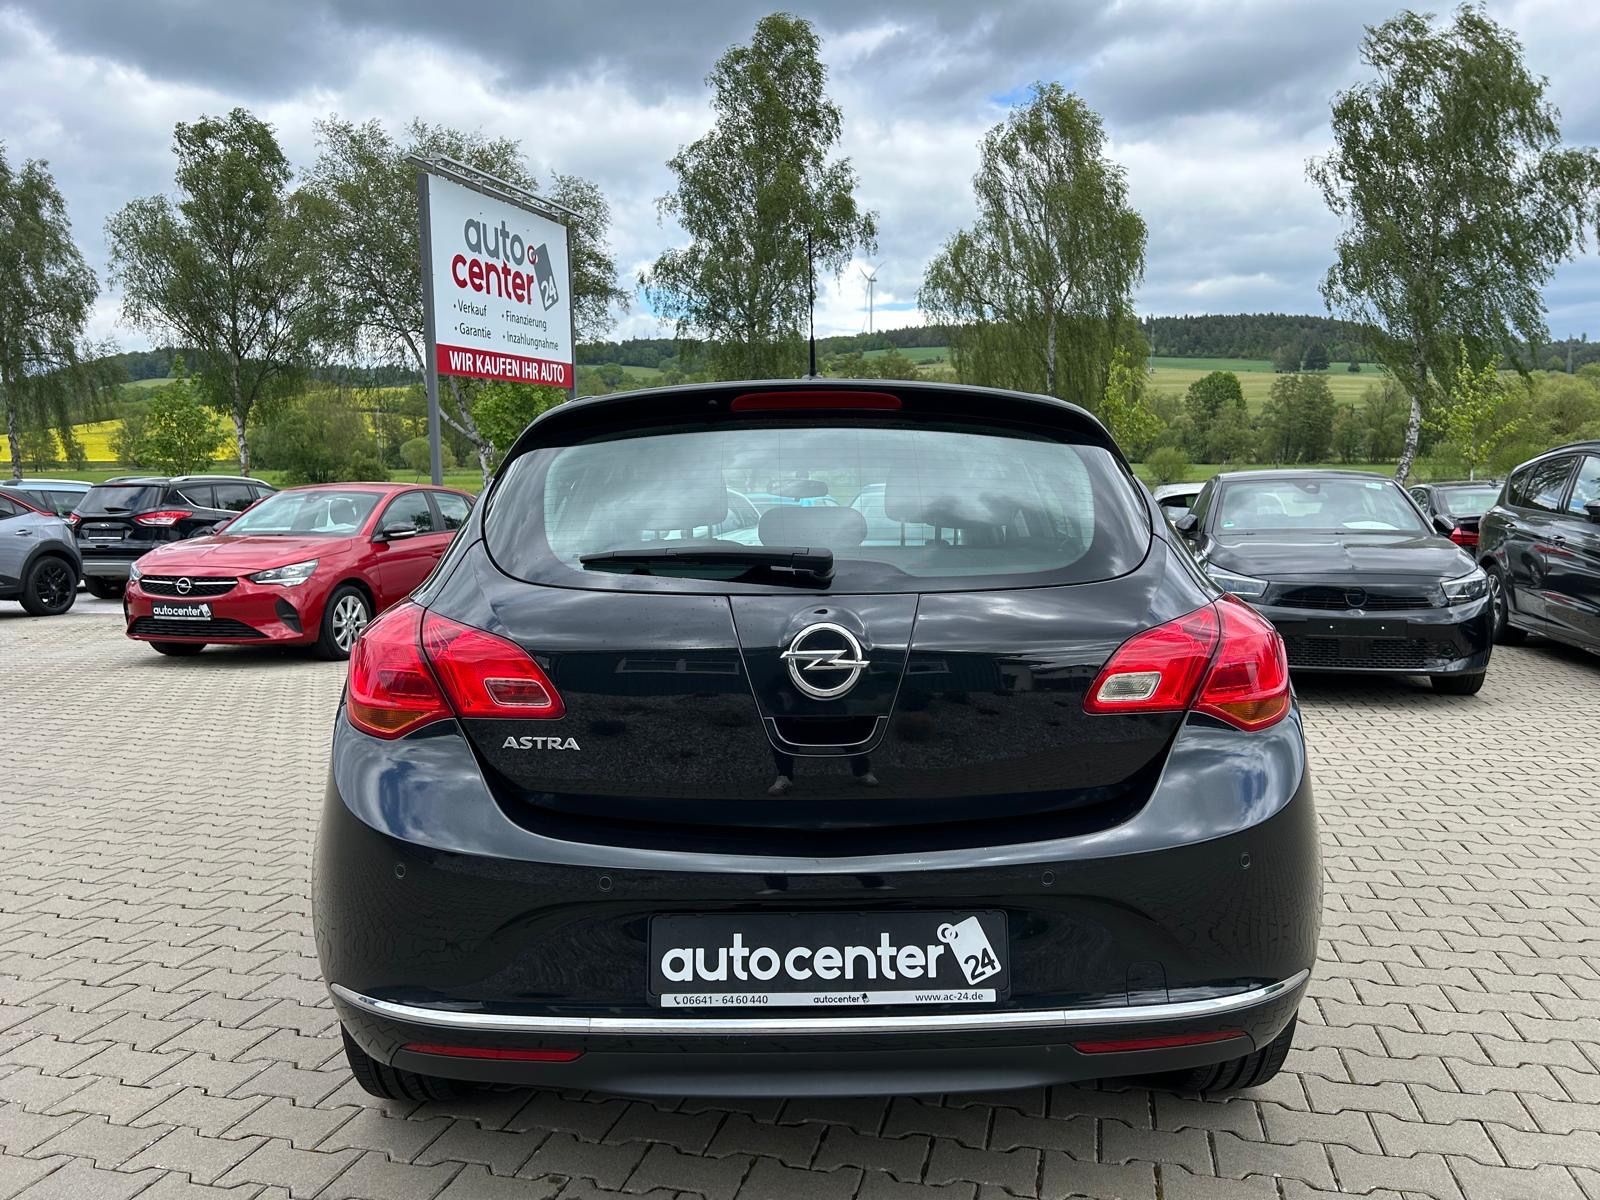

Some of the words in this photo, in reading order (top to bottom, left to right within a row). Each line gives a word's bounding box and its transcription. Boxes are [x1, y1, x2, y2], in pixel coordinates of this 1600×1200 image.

[464, 218, 525, 266] auto
[452, 253, 534, 305] center
[541, 275, 557, 306] 24
[457, 298, 487, 317] Verkauf
[459, 322, 492, 339] Garantie
[505, 310, 547, 332] Finanzierung
[506, 331, 559, 350] Inzahlungnahme
[449, 350, 473, 373] WIR
[476, 354, 520, 378] KAUFEN
[522, 360, 539, 380] IHR
[541, 362, 565, 383] AUTO
[153, 604, 200, 616] autocenter
[502, 736, 580, 751] ASTRA
[661, 932, 945, 982] autocenter
[964, 947, 996, 981] 24
[813, 994, 860, 1004] autocenter
[915, 991, 984, 1002] www.ac-24.de
